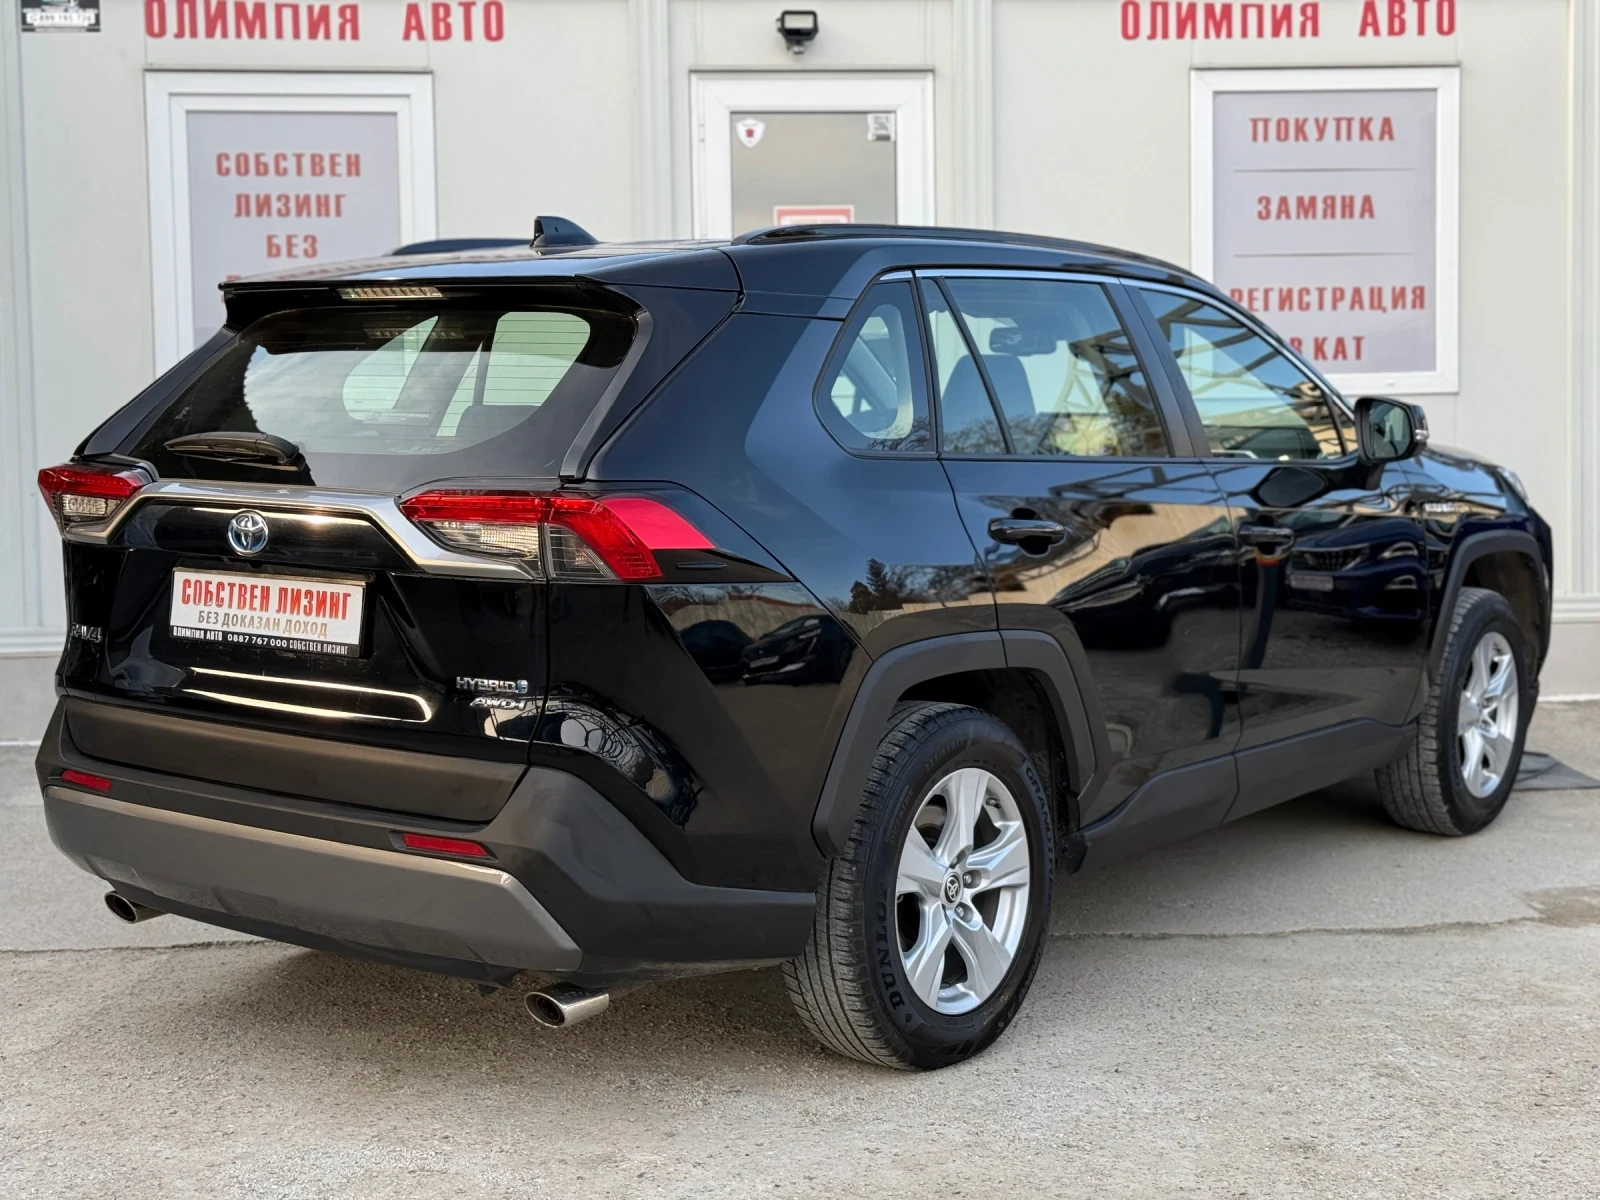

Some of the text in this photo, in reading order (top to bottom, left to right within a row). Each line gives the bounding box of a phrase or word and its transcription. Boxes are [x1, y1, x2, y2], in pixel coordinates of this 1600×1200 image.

[145, 0, 504, 42] ОЛИМПИЯ АВТО
[1120, 0, 1456, 41] ОЛИМПИЯ АВТО
[1249, 116, 1395, 142] ПОКУПКА
[215, 152, 361, 177] СОБСТВЕН
[234, 193, 346, 218] ЛИЗИНГ
[1257, 194, 1375, 221] ЗАМЯНА
[265, 234, 318, 259] БЕЗ
[1230, 285, 1426, 313] РЕГИСТРАЦИЯ
[1313, 336, 1365, 361] КАТ
[181, 578, 352, 620] СОБСТВЕН ЛИЗИНГ
[198, 610, 328, 639] БЕЗ ДОКАЗАН ДОХОД
[173, 626, 349, 655] ОЛИМПИЯ АВТО 0887 767 000 СОБСТВЕН ЛИЗИНГ
[456, 676, 517, 693] HYBRID
